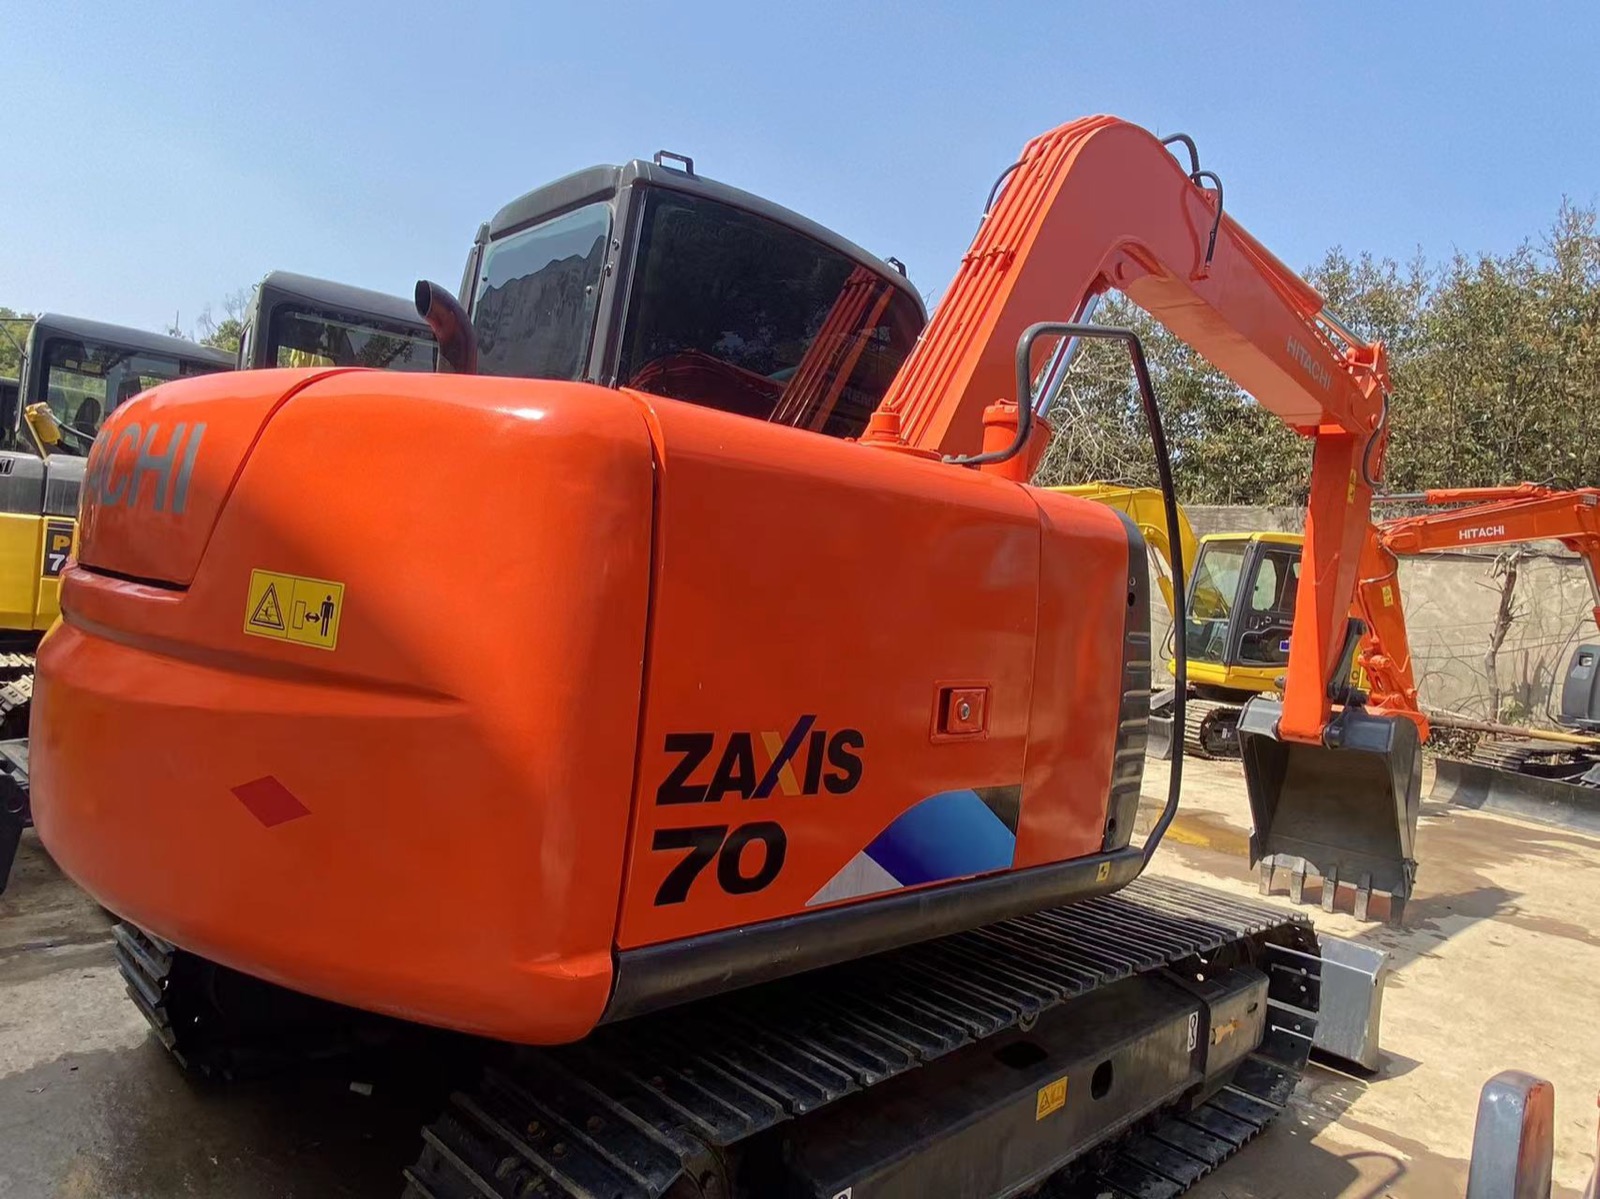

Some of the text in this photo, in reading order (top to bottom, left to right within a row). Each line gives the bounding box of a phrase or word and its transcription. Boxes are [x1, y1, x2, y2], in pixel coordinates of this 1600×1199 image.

[1286, 335, 1332, 391] HITACHI
[1458, 525, 1505, 540] HITACHI
[656, 714, 865, 806] ZAXIS
[652, 820, 787, 907] 70
